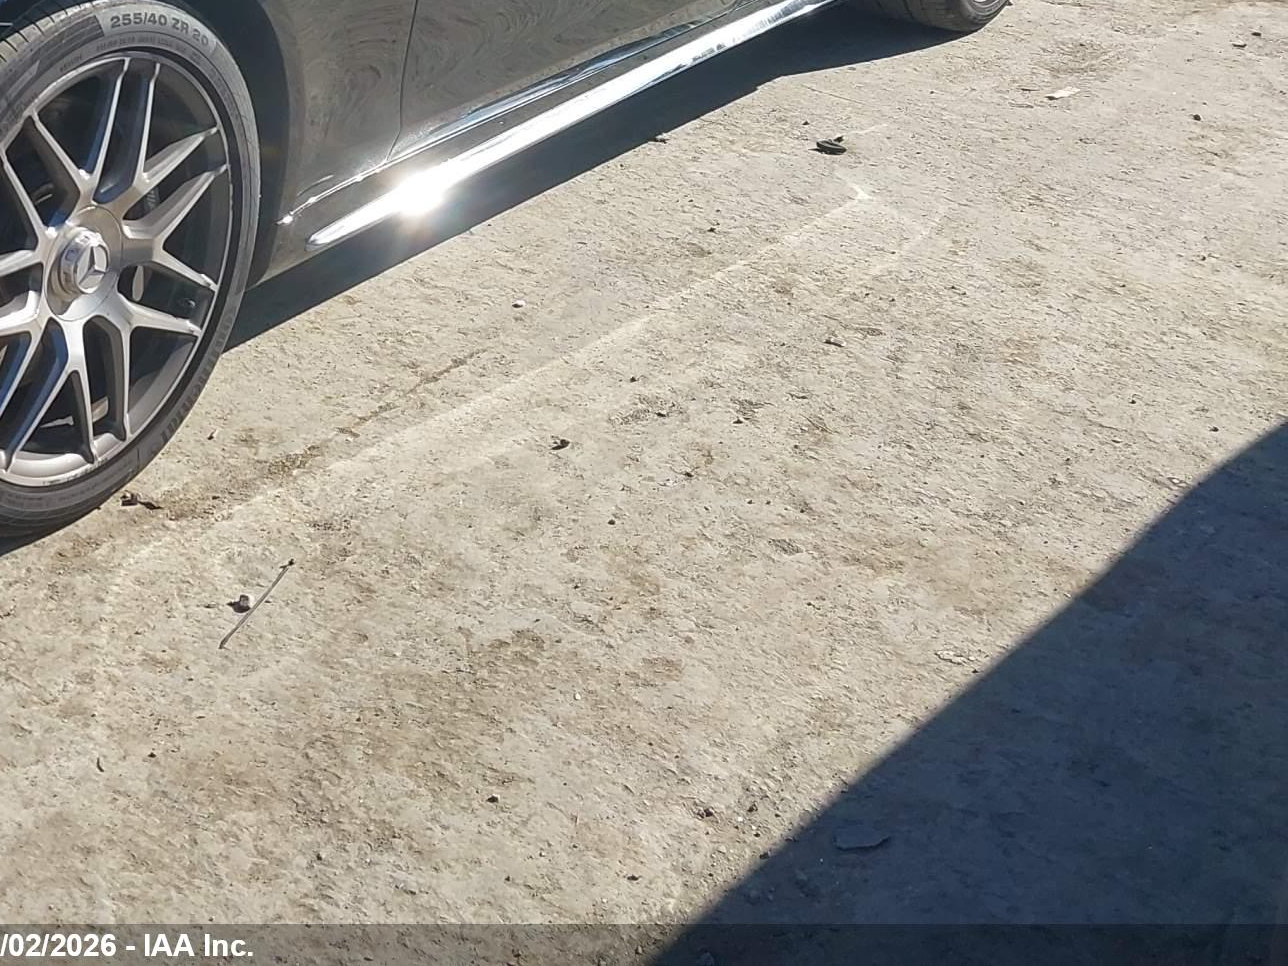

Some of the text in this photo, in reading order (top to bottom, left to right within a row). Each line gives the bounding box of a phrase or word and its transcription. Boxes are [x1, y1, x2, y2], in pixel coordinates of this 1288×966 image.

[110, 12, 209, 47] 255/40 ZR 20
